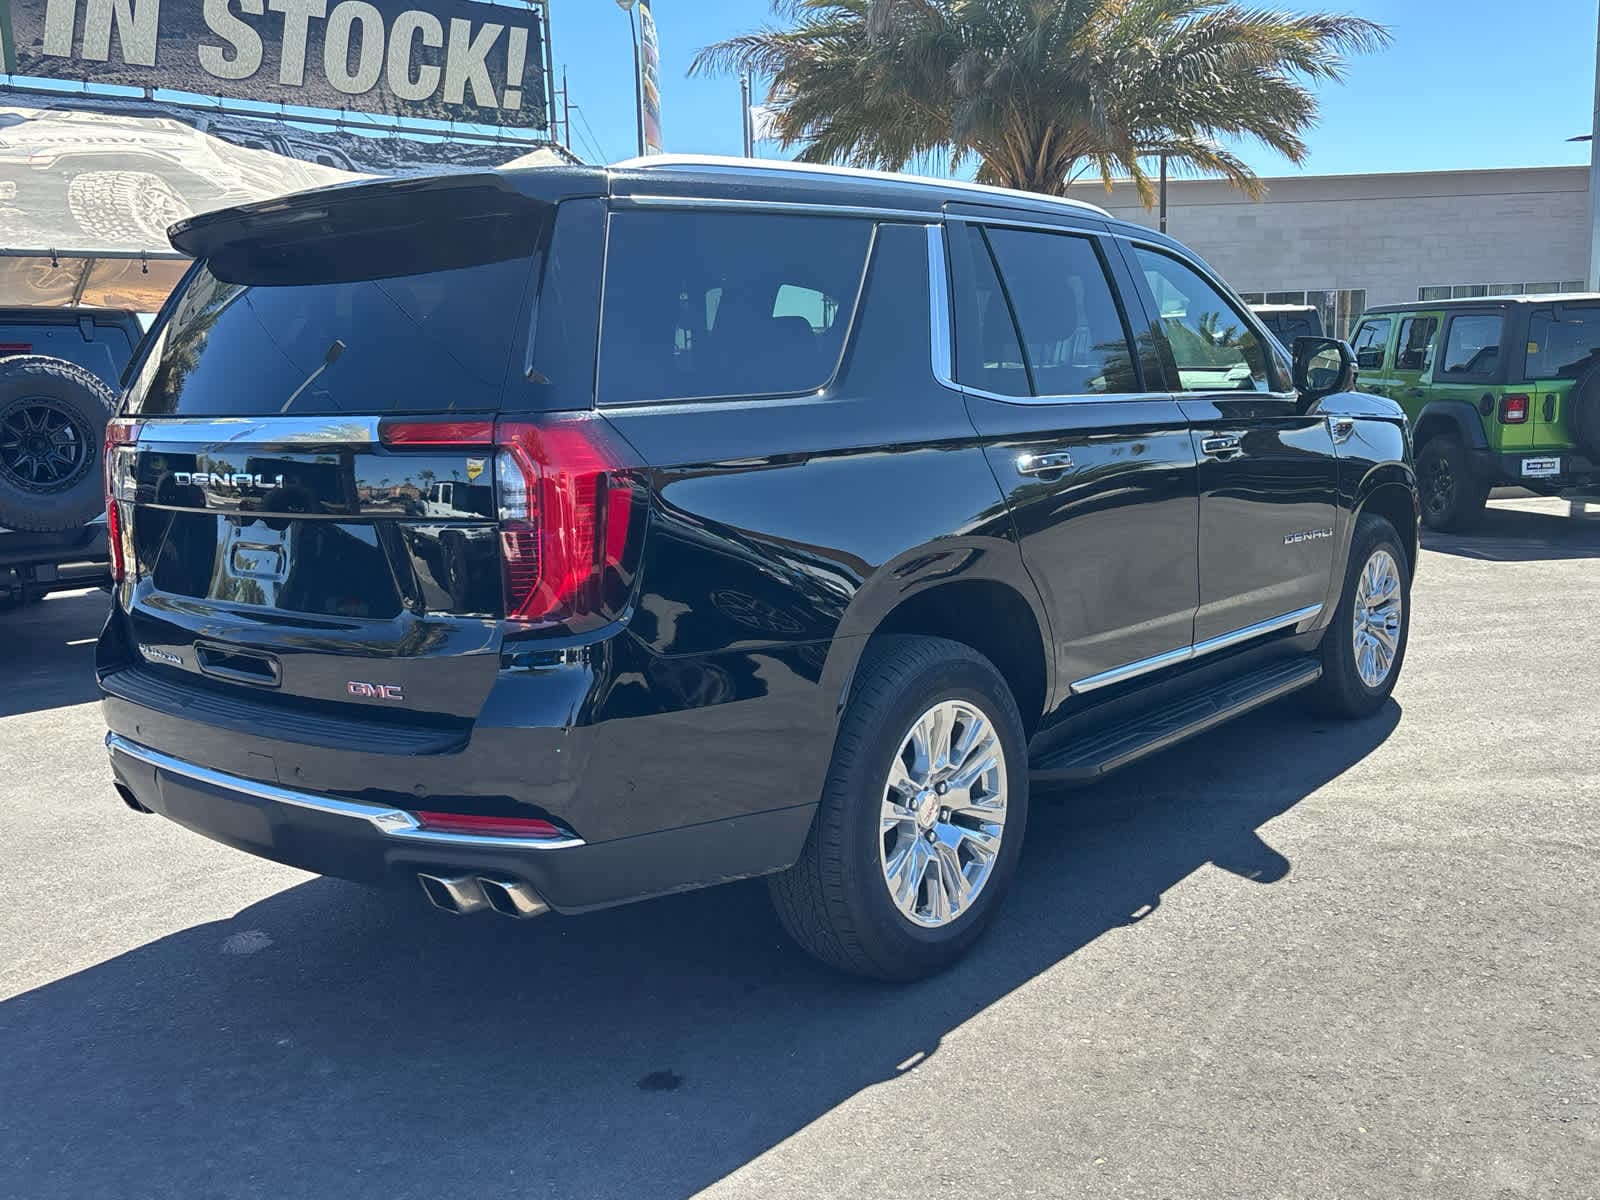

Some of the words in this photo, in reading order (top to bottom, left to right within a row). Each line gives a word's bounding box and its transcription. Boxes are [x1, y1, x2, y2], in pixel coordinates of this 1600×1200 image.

[42, 0, 161, 67] IN
[198, 0, 529, 111] STOCK!
[174, 472, 283, 489] DENALI
[1283, 527, 1333, 545] DENALI
[346, 681, 404, 700] GMC
